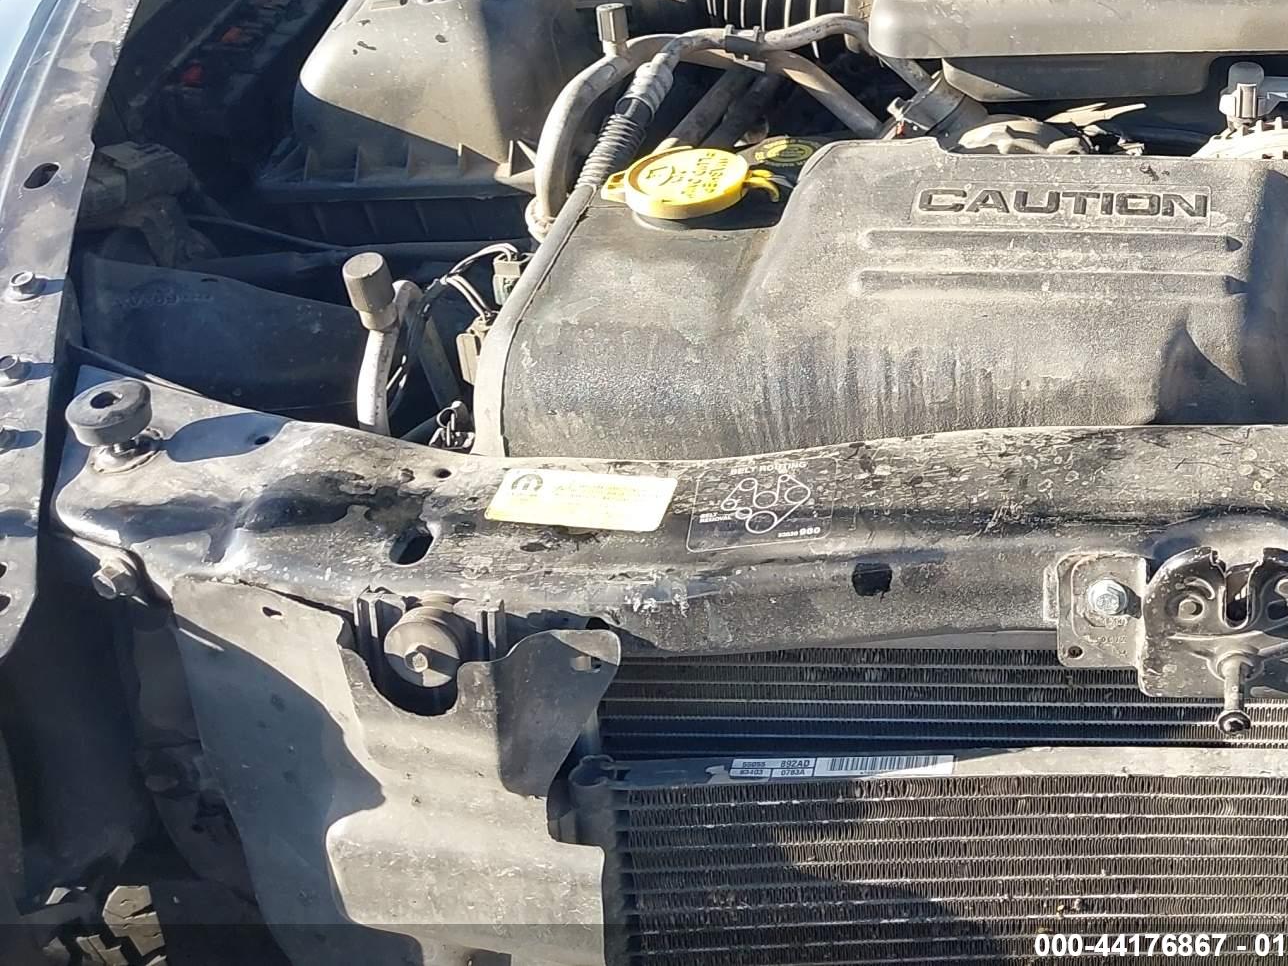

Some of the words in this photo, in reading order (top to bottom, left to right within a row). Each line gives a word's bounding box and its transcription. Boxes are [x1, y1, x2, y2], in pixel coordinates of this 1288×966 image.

[917, 188, 1209, 219] CAUTION
[730, 465, 757, 475] BELT
[759, 461, 808, 473] ROUTING
